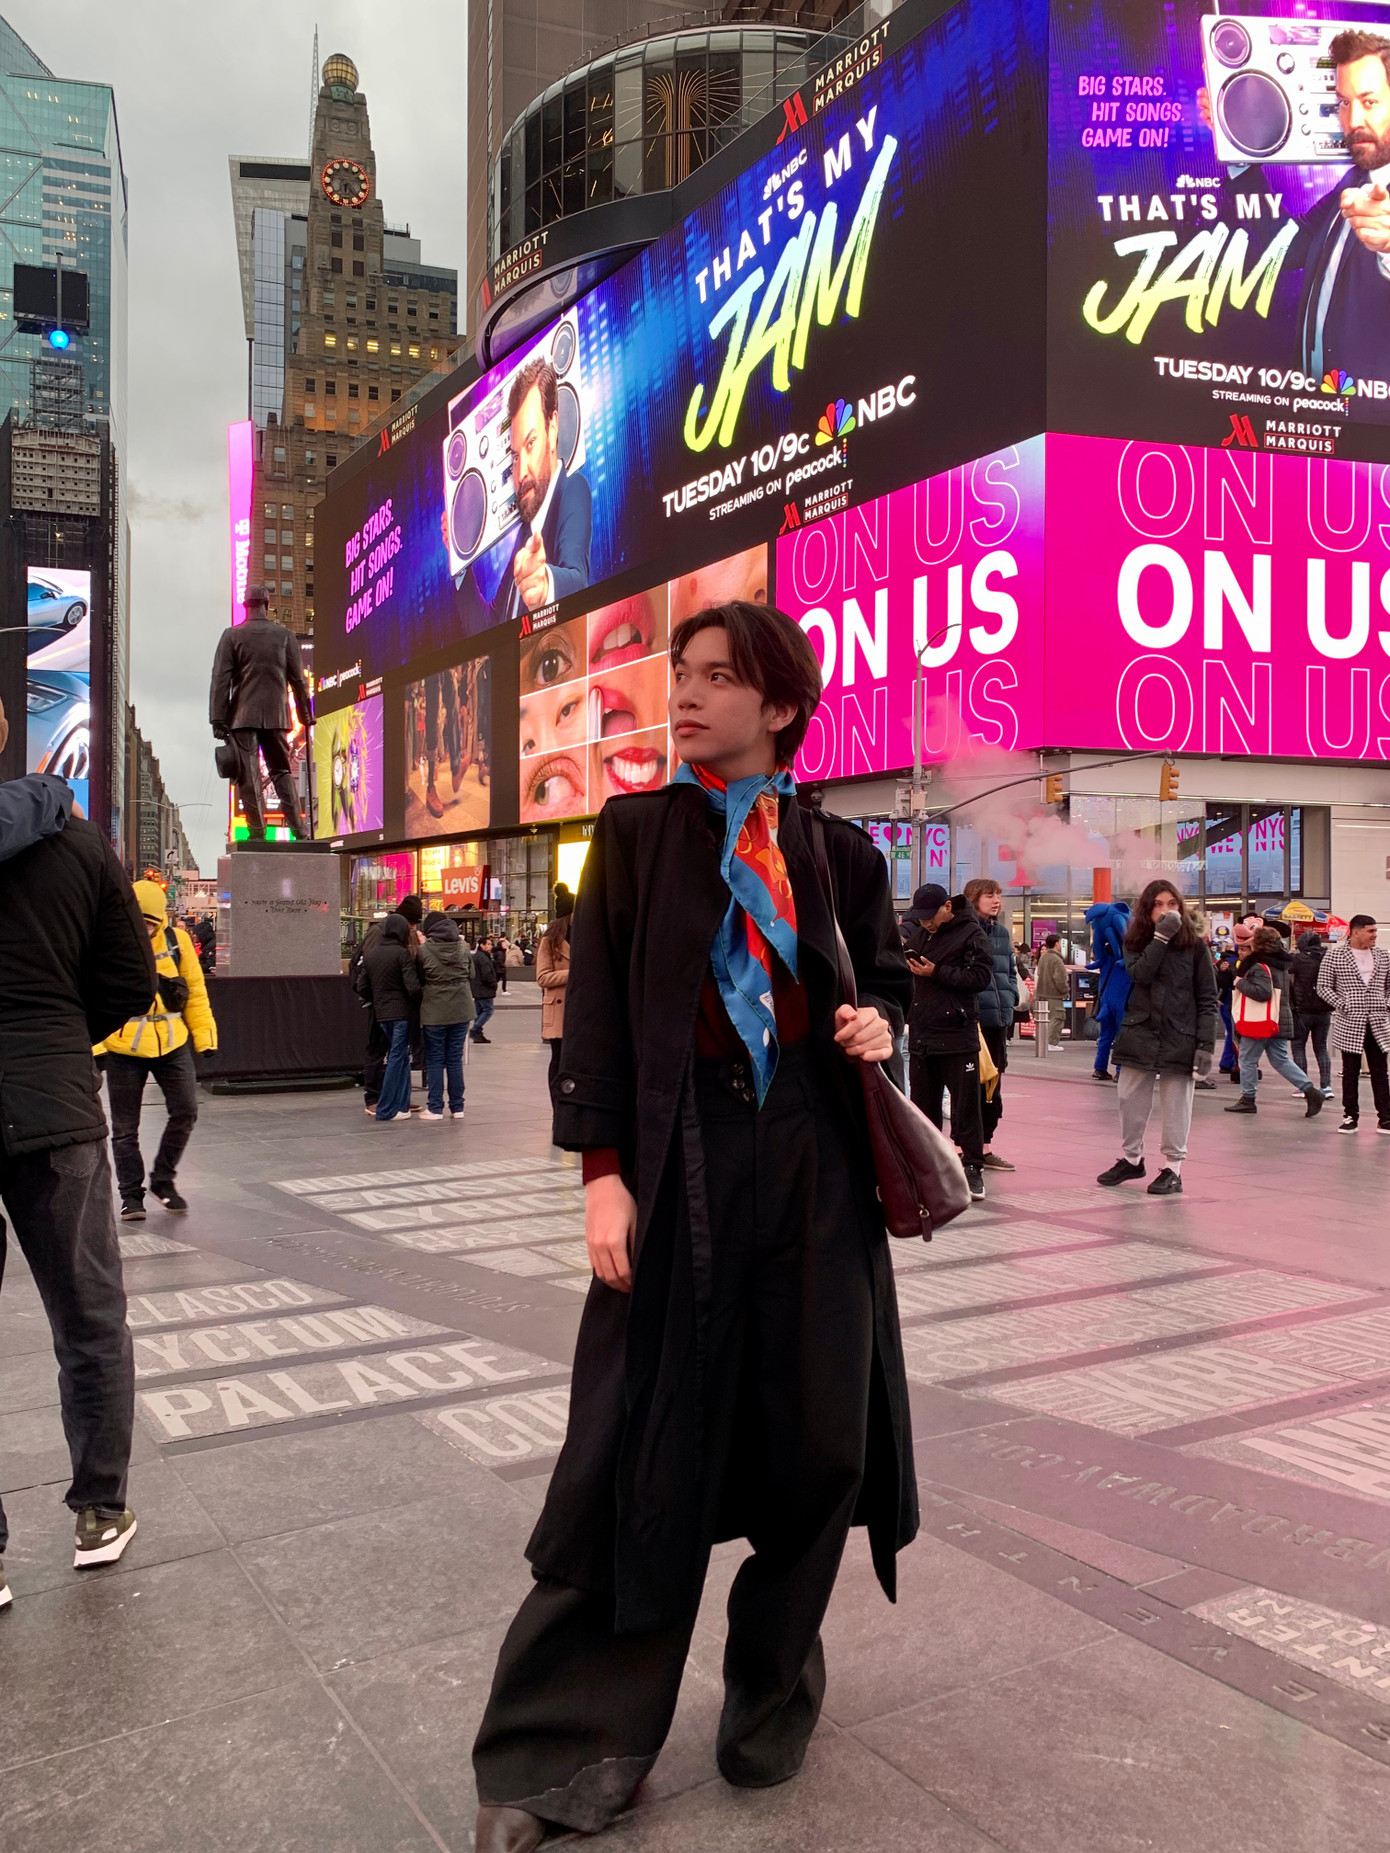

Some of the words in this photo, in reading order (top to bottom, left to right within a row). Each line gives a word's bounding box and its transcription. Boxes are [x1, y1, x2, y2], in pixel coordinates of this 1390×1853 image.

[815, 21, 890, 91] MARRIOTT
[814, 51, 881, 112] MARQUIS
[1078, 76, 1106, 96] BIG
[1112, 76, 1167, 96] STARS.
[1092, 102, 1118, 122] HIT
[1125, 102, 1185, 122] SONGS.
[1081, 129, 1131, 148] GAME
[1139, 128, 1169, 148] ON!
[781, 148, 808, 181] NBC
[1195, 177, 1221, 188] NBC
[695, 180, 805, 304] THAT'S
[824, 105, 878, 188] MY
[1098, 194, 1218, 221] THAT'S
[1237, 193, 1283, 219] MY
[494, 231, 548, 278] MARRIOTT
[494, 254, 541, 295] MARQUIS
[684, 134, 898, 452] JAM
[1082, 217, 1299, 344] JAM
[1154, 356, 1254, 385] TUESDAY
[1257, 370, 1316, 392] 10/9c
[392, 405, 418, 432] MARRIOTT
[1212, 390, 1270, 404] STREAMING
[1274, 396, 1289, 407] ON
[1293, 397, 1345, 413] peacock
[392, 419, 415, 444] MARQUIS
[662, 455, 746, 518] TUESDAY
[751, 432, 811, 477] 10/9c
[858, 375, 917, 427] NBC
[1266, 420, 1341, 438] MARRIOTT
[1266, 436, 1332, 452] MARQUIS
[709, 487, 765, 520] STREAMING
[766, 480, 782, 495] ON
[785, 446, 844, 495] peacock
[805, 479, 853, 508] MARRIOTT
[1118, 440, 1272, 544] ON
[1308, 458, 1390, 552] U
[792, 494, 889, 604] ON
[914, 445, 1019, 565] US
[805, 495, 847, 521] MARQUIS
[345, 531, 360, 568] BIG
[363, 498, 394, 550] STARS.
[350, 559, 366, 596] HIT
[368, 525, 403, 579] SONGS.
[345, 587, 373, 633] GAME
[375, 566, 394, 607] ON!
[533, 603, 559, 620] MARRIOTT
[1117, 544, 1272, 653] ON
[1307, 558, 1390, 659] U
[533, 615, 556, 630] MARQUIS
[799, 587, 888, 691] ON
[913, 550, 1019, 668] US
[794, 687, 888, 783] ON
[912, 659, 1018, 760] US
[1116, 655, 1271, 756] ON
[1306, 666, 1390, 759] U
[360, 1170, 583, 1205] AMSTER
[349, 1194, 580, 1230] LYRIC
[393, 1215, 579, 1243] HELEN
[1022, 1242, 1174, 1273] BROOKS
[126, 1281, 313, 1326] ELASCO
[1130, 1276, 1268, 1302] SAMUEL
[1171, 1281, 1369, 1322] FRIEDMAN
[915, 1298, 1154, 1344] BARRYMORE
[143, 1343, 530, 1437] PALACE
[1062, 1347, 1345, 1419] KERR
[437, 1391, 571, 1457] CO
